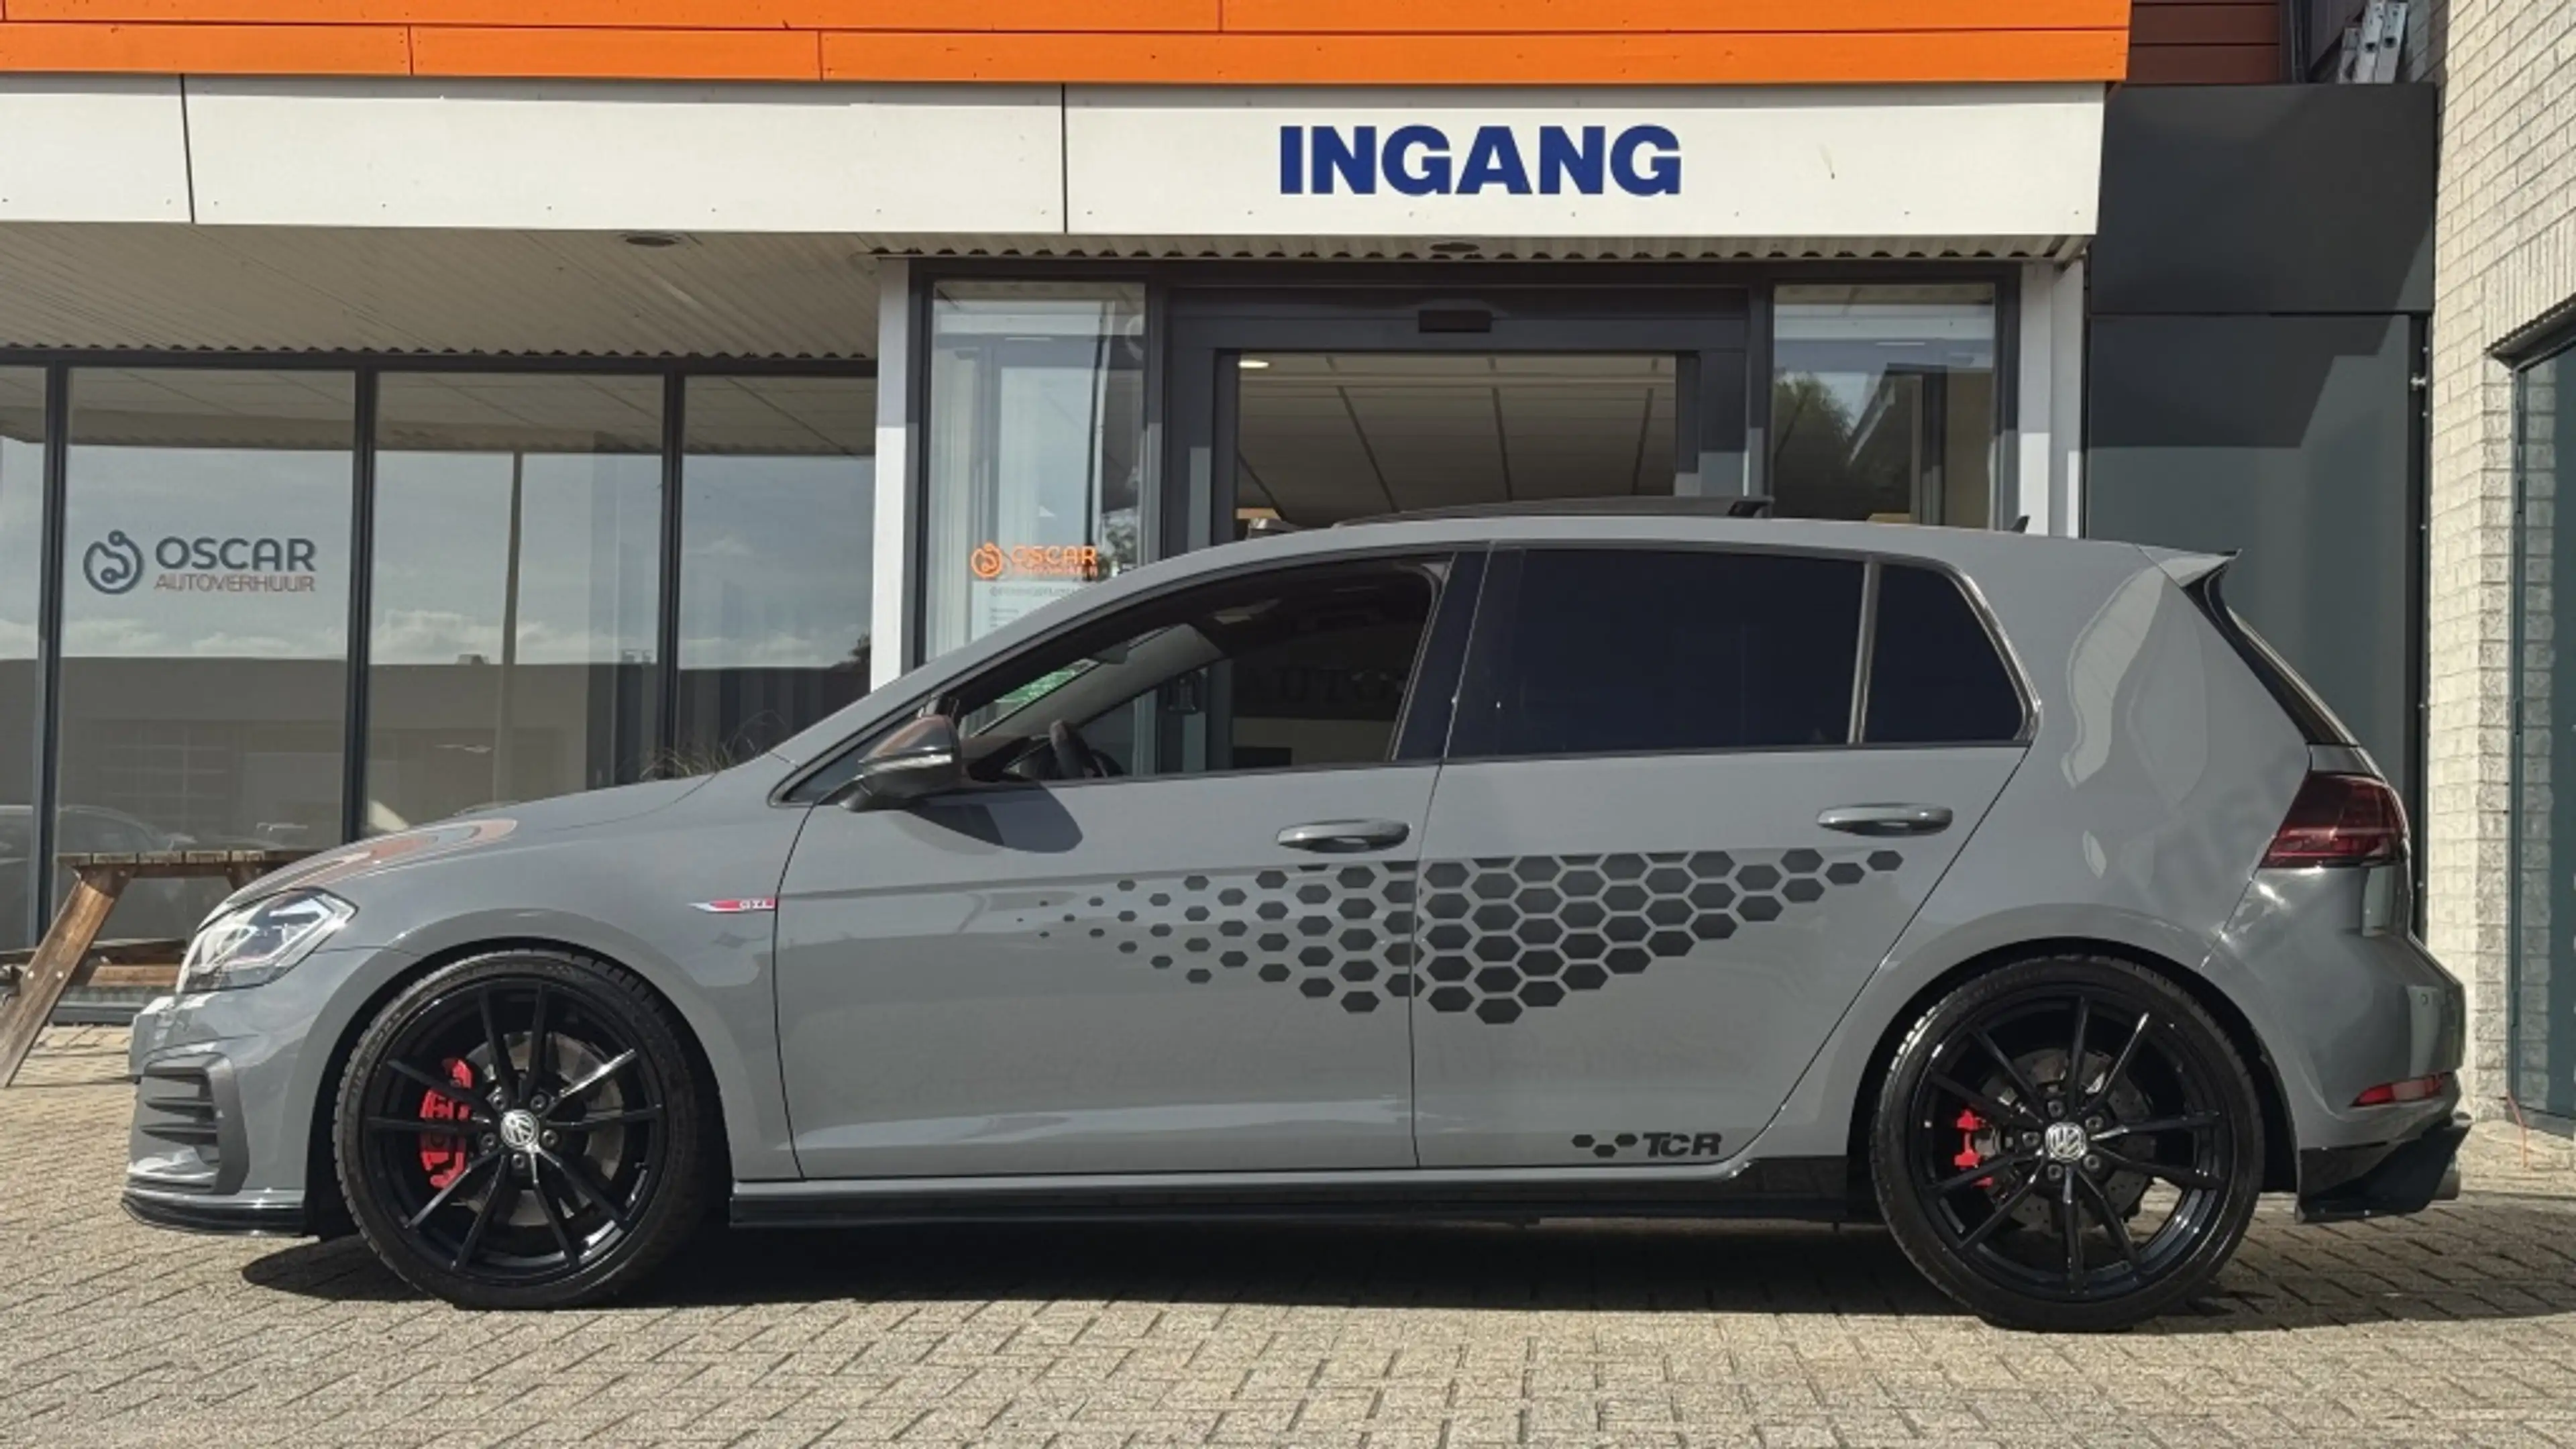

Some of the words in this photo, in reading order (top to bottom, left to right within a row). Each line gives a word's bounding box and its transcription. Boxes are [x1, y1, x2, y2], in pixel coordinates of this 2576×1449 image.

[1280, 124, 1682, 197] INGANG
[156, 537, 316, 572] OSCAR
[1012, 545, 1096, 565] OSCAR
[154, 574, 316, 592] AUTOVERHUUR
[1643, 1132, 1722, 1157] TCR
